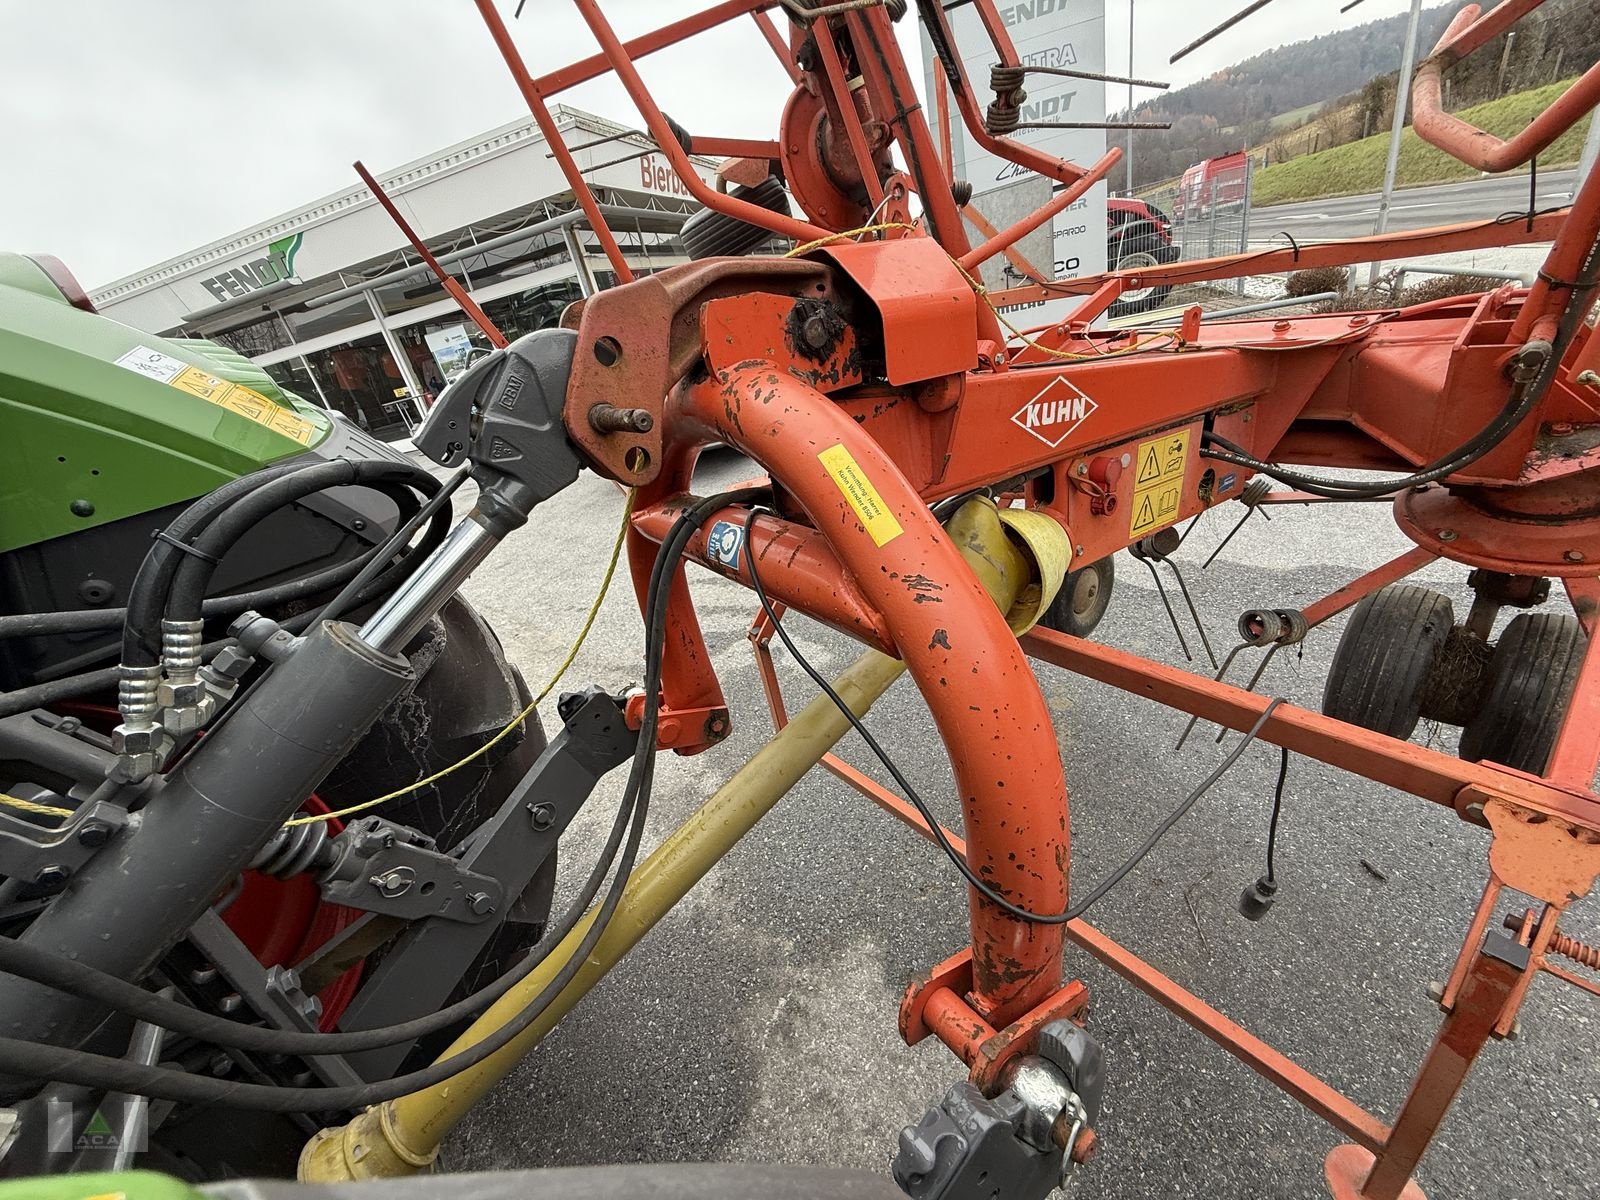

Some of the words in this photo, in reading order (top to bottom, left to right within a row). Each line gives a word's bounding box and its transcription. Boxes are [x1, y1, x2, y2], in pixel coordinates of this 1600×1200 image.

[200, 250, 291, 302] FENDT
[502, 377, 523, 406] CBM
[1026, 398, 1086, 427] KUHN
[848, 484, 864, 506] Wender
[867, 497, 882, 516] Harrer
